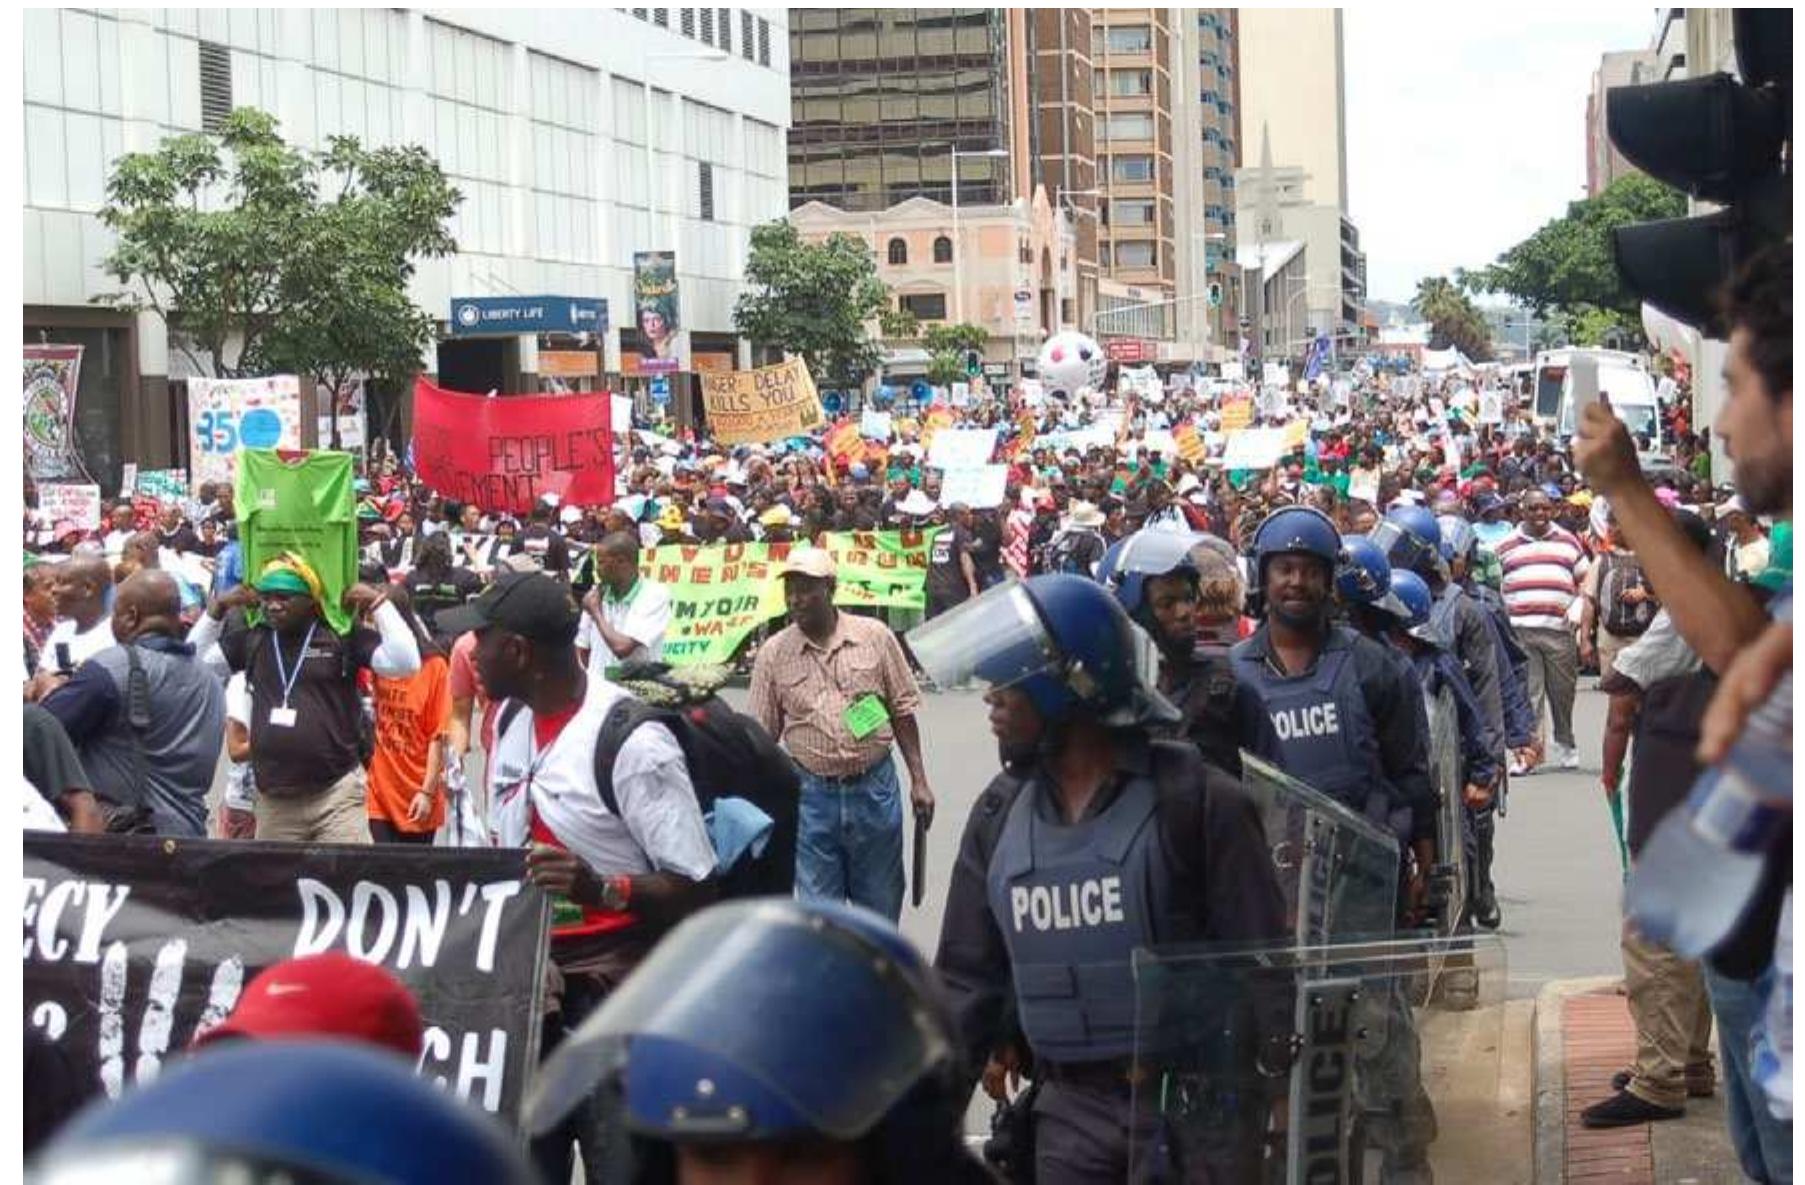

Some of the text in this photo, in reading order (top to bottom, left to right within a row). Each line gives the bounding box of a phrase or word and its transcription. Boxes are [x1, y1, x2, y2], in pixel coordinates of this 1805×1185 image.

[482, 306, 544, 321] LIBERTY LIFE
[760, 385, 796, 409] YOU
[488, 427, 608, 474] PEOPLE'S
[293, 877, 522, 973] DON'T
[1011, 876, 1124, 932] POLICE
[414, 1025, 508, 1112] CH
[1304, 1005, 1349, 1185] OLICE
